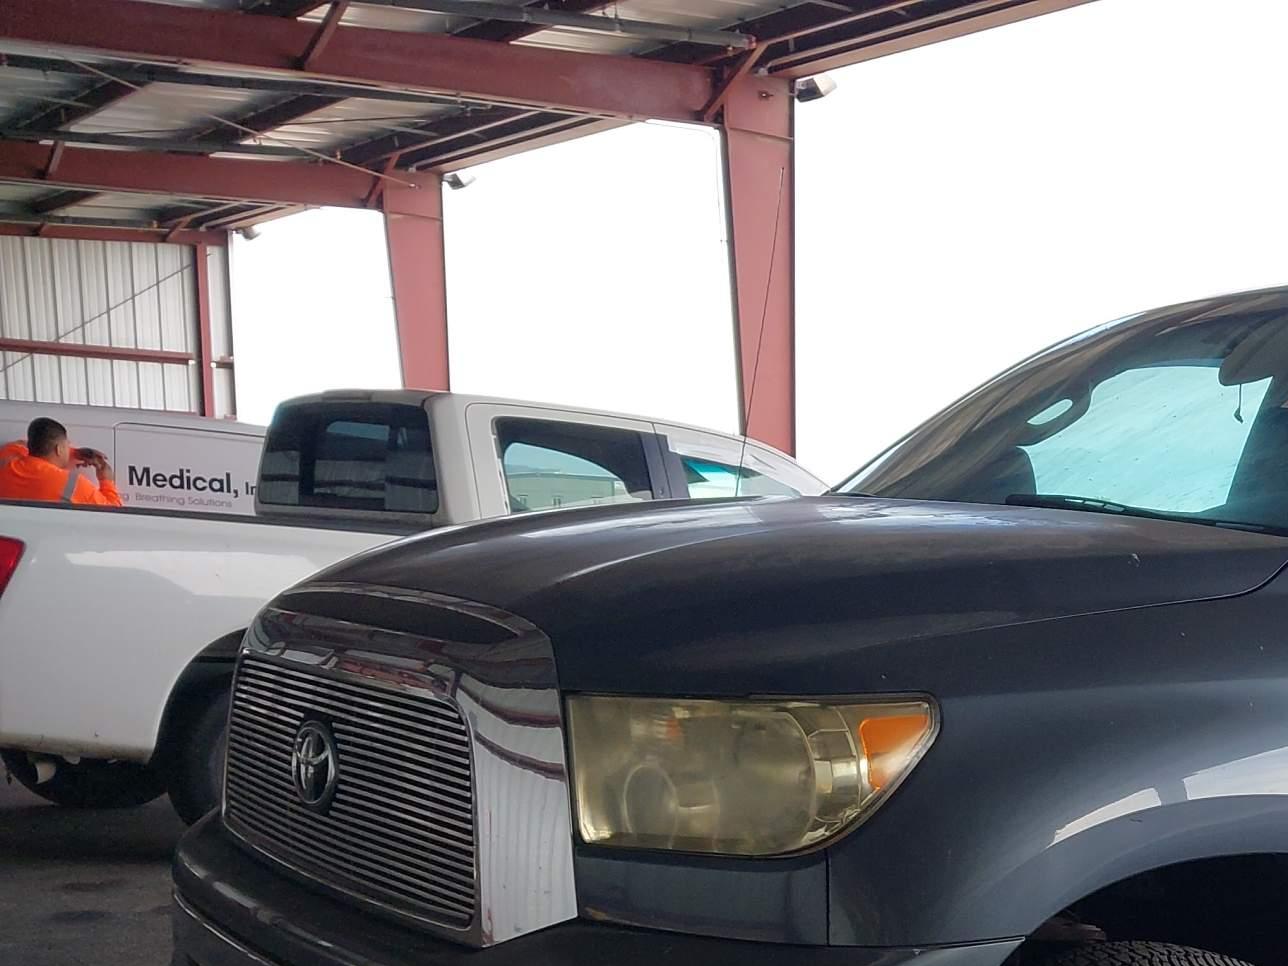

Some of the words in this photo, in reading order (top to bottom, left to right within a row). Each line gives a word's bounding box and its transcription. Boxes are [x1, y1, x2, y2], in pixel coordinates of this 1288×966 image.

[128, 465, 239, 498] Medical,
[135, 493, 186, 506] Breathing
[188, 496, 233, 508] Solutions
